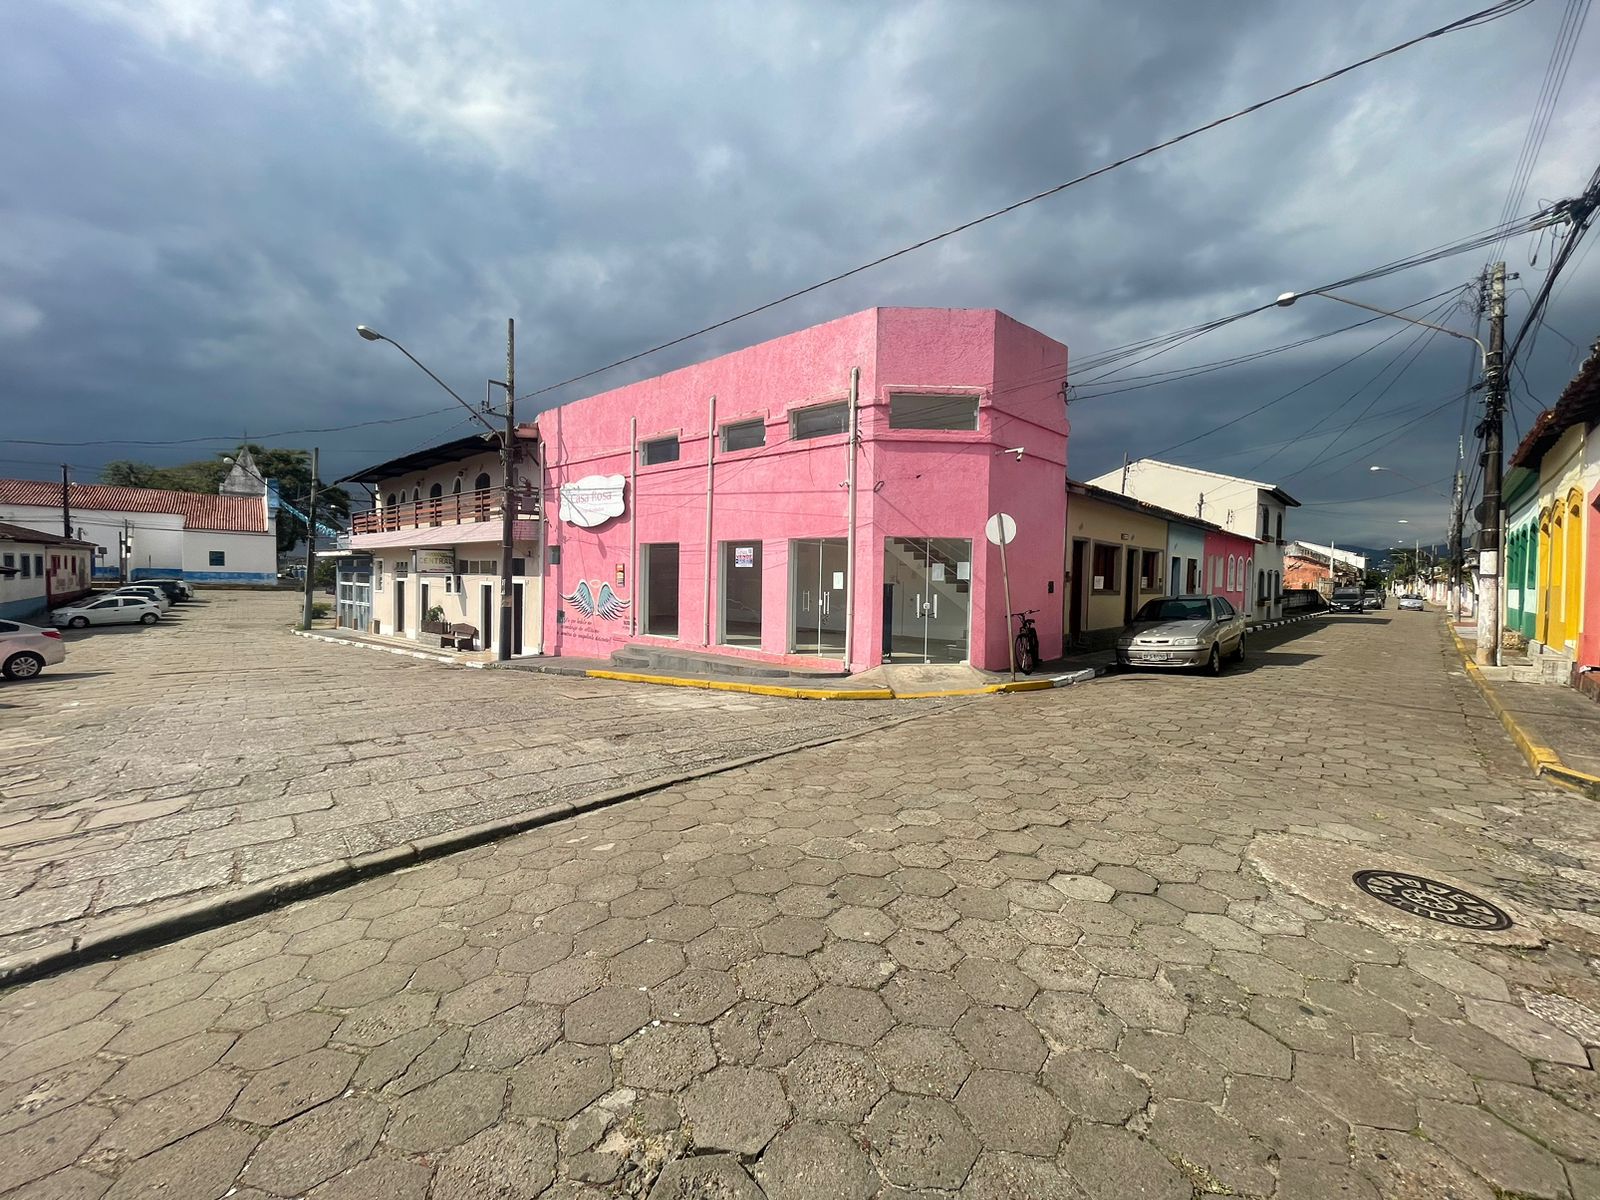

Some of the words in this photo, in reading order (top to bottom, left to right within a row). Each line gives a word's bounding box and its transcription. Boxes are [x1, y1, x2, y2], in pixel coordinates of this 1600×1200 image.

[570, 492, 589, 504] Casa
[591, 491, 612, 502] Rosa
[420, 557, 453, 565] CENTRAL
